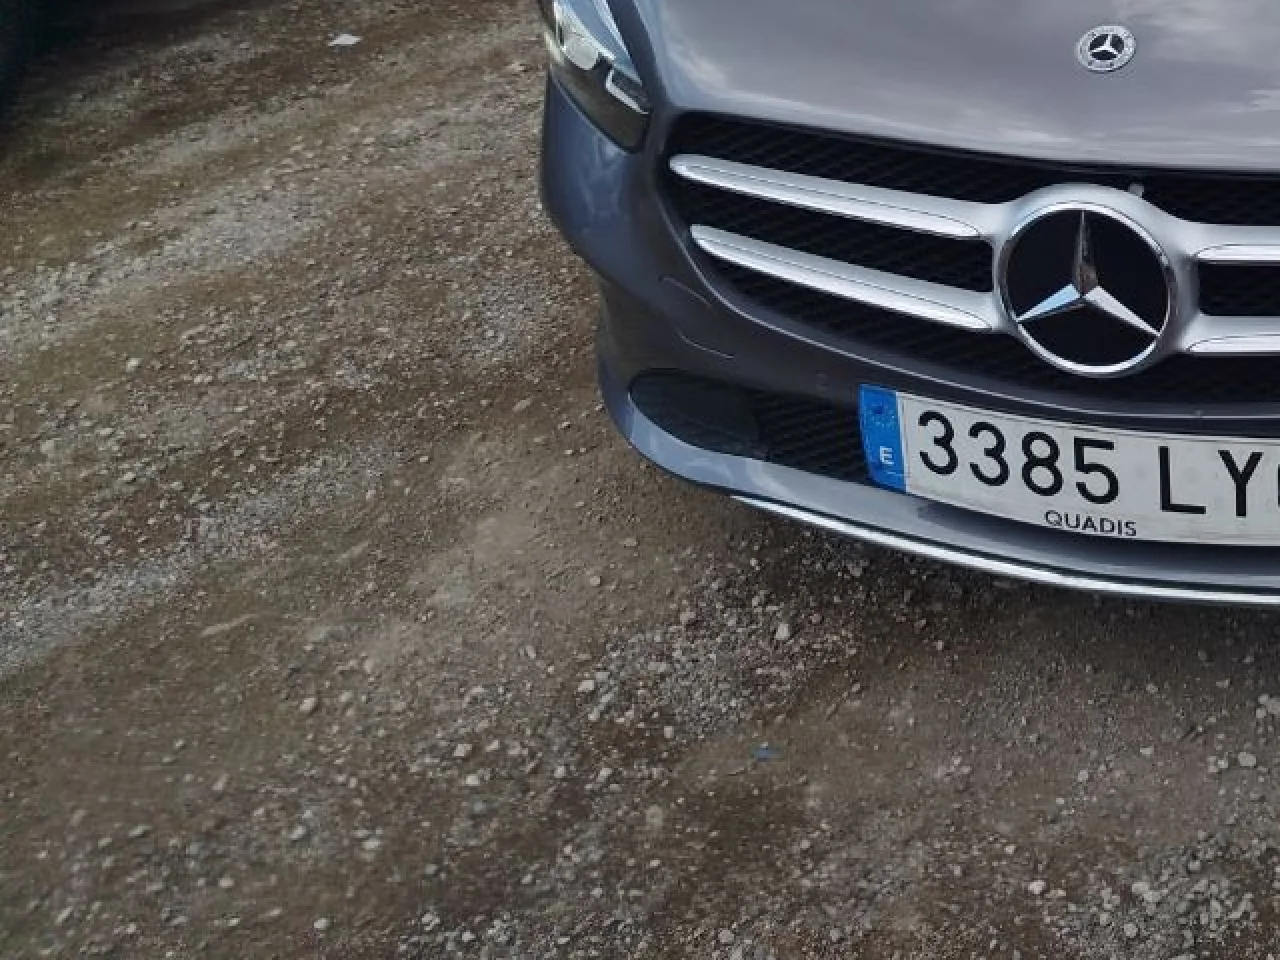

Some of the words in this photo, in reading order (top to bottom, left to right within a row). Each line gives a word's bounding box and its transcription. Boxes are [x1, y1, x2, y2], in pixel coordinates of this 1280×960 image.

[879, 445, 895, 465] E
[918, 409, 1120, 505] 3385
[1044, 509, 1137, 537] QUADIS
